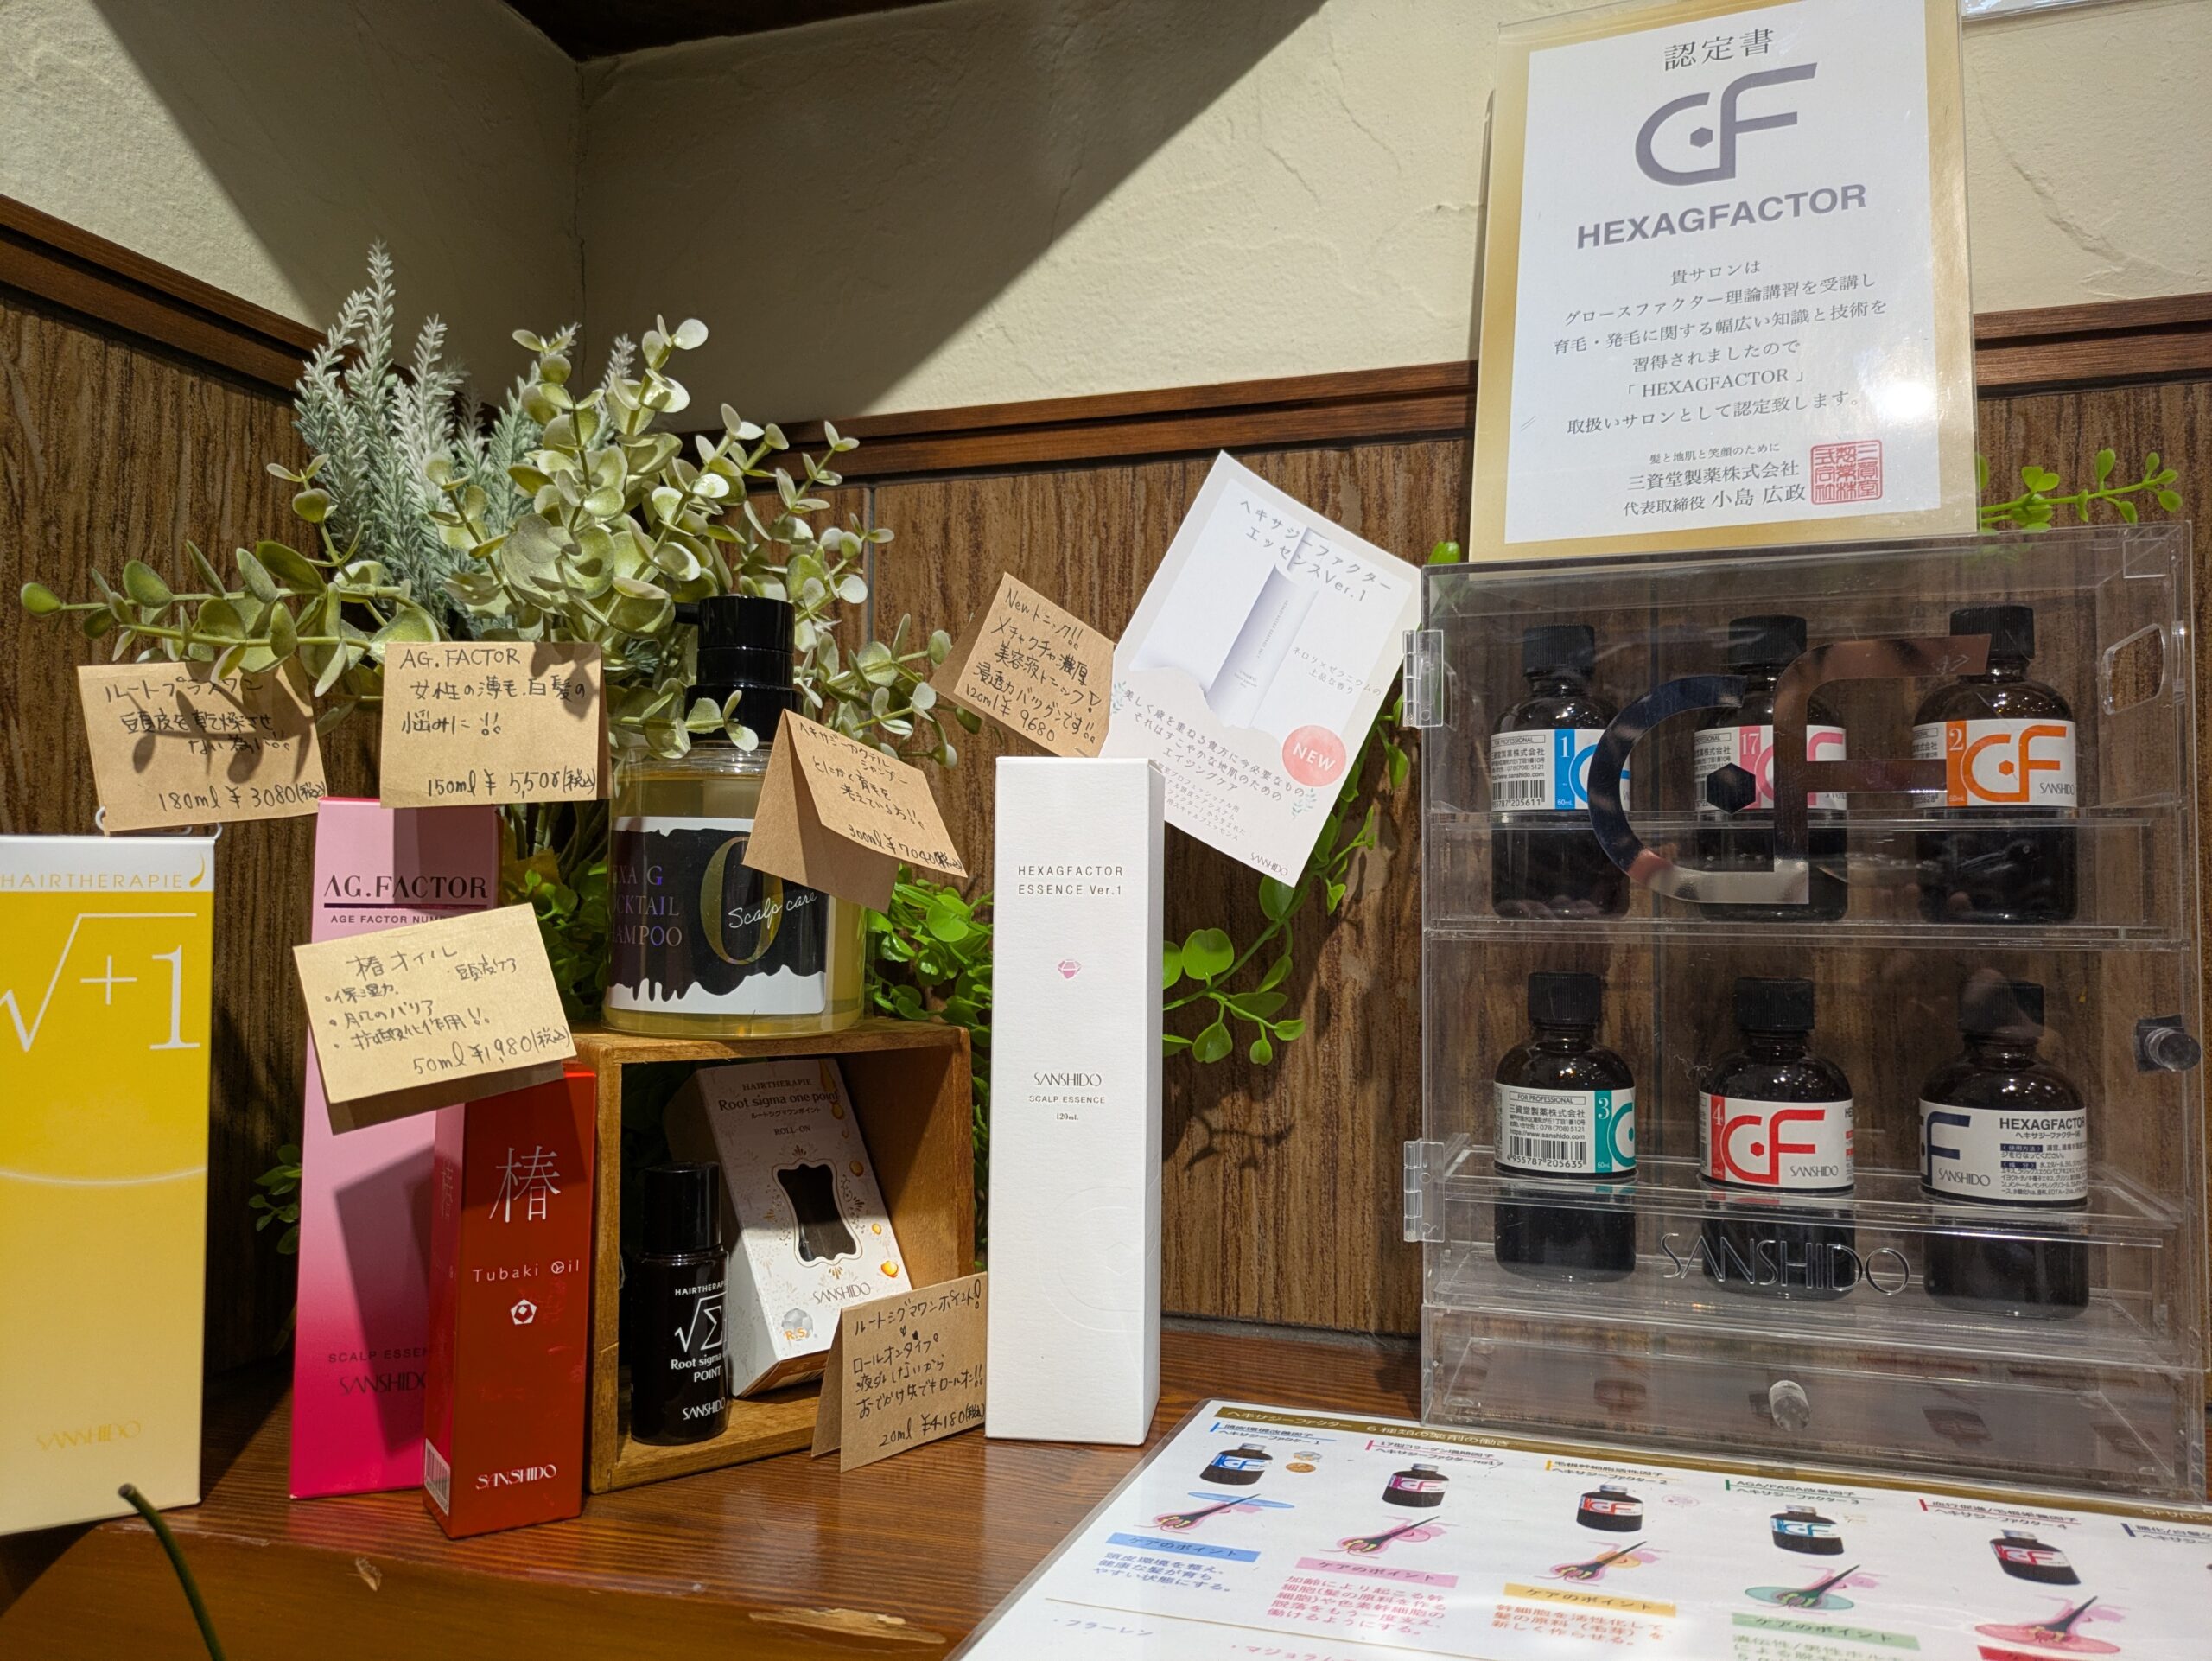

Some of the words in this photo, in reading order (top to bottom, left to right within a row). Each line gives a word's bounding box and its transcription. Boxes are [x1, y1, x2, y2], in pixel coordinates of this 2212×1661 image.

[1664, 28, 1775, 71] 認定書
[1577, 183, 1866, 249] HEXAGFACTOR
[1671, 260, 1760, 286] 貴サロンは
[1564, 273, 1875, 328] グロースファクター理論講習を受講し
[1554, 299, 1887, 355] 育毛・発毛に関する幅広い知識と技術を
[1632, 340, 1801, 372] 習得されましたので
[1567, 390, 1859, 435] 取扱いサロンとして認定致します。
[1649, 442, 1780, 466] 髪と地肌と笑顔のために
[1627, 460, 1800, 492] 三資堂製薬株式会社
[1623, 493, 1706, 517] 代表取締役
[1238, 498, 1393, 590] ヘキサジーファクター
[1741, 733, 1759, 755] 17
[1948, 728, 1963, 751] 2
[1134, 711, 1282, 802] それはすこやかな地肌のための
[1292, 741, 1336, 771] NEW
[1163, 747, 1238, 792] エイジングケア
[428, 770, 475, 797] 150ml
[1, 874, 182, 888] HAIRTHERAPIE
[1018, 865, 1123, 876] HEXAGFACTOR
[324, 875, 488, 899] AG.FACTOR
[1018, 884, 1083, 895] ESSENCE
[1090, 884, 1122, 895] Ver.1
[331, 915, 355, 924] AGE
[360, 915, 407, 924] FACTOR
[728, 897, 783, 931] Scalp
[785, 891, 817, 912] care
[742, 1079, 812, 1091] HAIRTHERAPIE
[1033, 1072, 1102, 1087] SANSHIDO
[718, 1098, 750, 1111] Root
[752, 1094, 786, 1108] sigma
[789, 1093, 810, 1103] one
[812, 1091, 838, 1104] point
[1029, 1095, 1059, 1104] SCALP
[1062, 1095, 1105, 1104] ESSENCE
[1529, 1095, 1573, 1104] PROFESSIONAL
[1598, 1098, 1610, 1119] 3
[1713, 1104, 1723, 1126] 4
[774, 1125, 811, 1136] ROLL-ON
[1547, 1160, 1583, 1168] 205635
[1789, 1165, 1839, 1177] SANSHIDO
[489, 1145, 562, 1223] 椿
[1938, 1168, 1991, 1187] SANSHIDO
[473, 1263, 539, 1282] Tubaki
[1660, 1232, 1910, 1295] SANSHIDO
[812, 1282, 872, 1304] SANSHIDO
[328, 1351, 377, 1363] SCALP
[671, 1357, 696, 1370] Root
[698, 1354, 722, 1368] sigma
[694, 1365, 722, 1383] POINT
[475, 1464, 557, 1490] SANSHIDO
[1129, 1537, 1237, 1557] ケアのポイント
[1319, 1561, 1435, 1582] ケアのポイント
[1527, 1588, 1652, 1611] ケアのポイント
[1756, 1617, 1893, 1643] ケアのポイント
